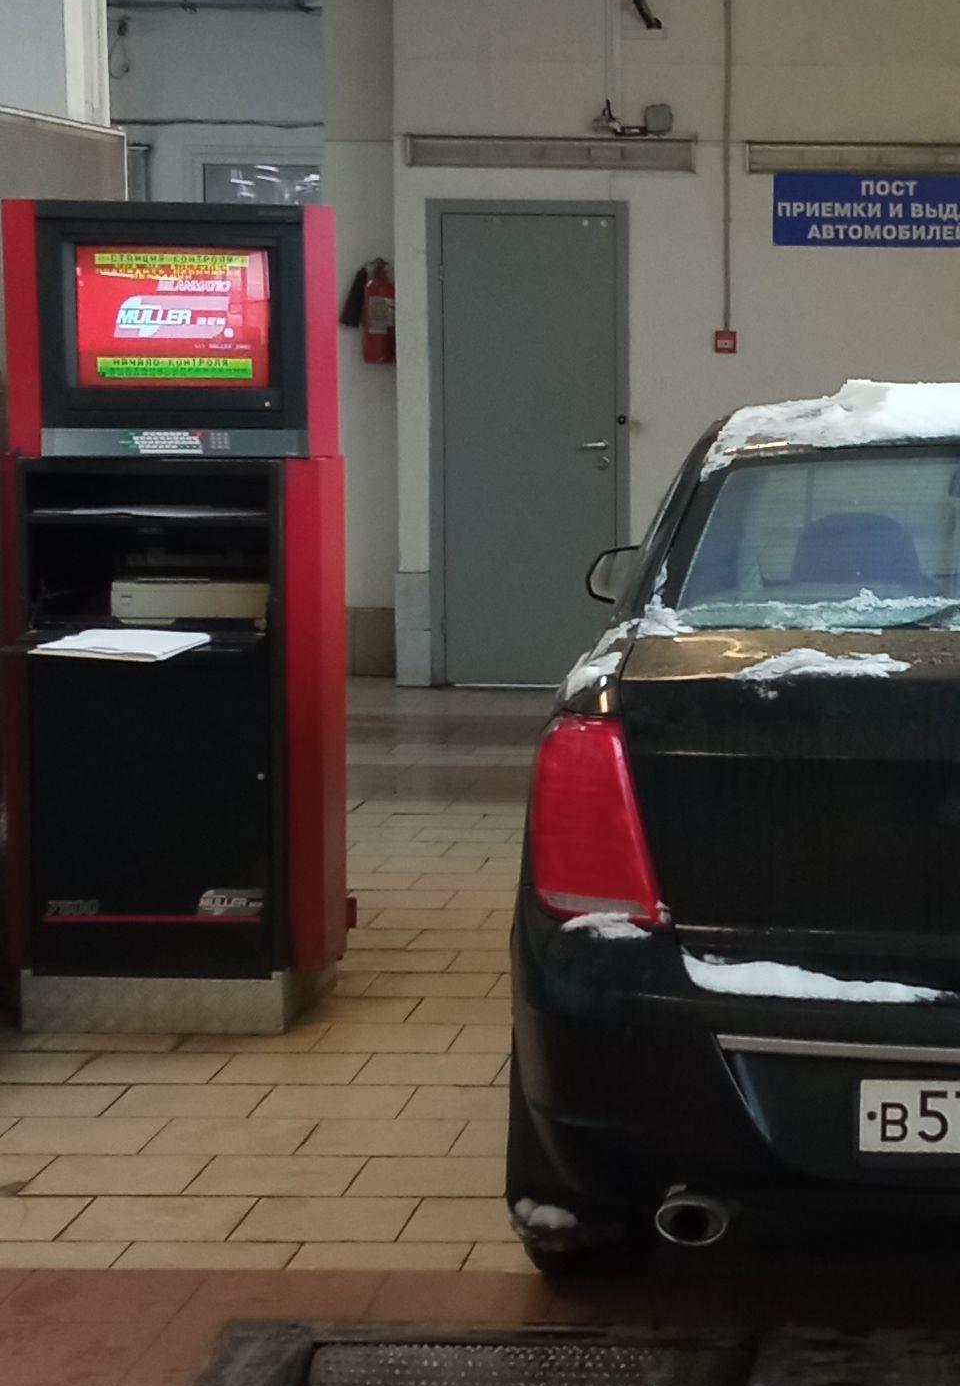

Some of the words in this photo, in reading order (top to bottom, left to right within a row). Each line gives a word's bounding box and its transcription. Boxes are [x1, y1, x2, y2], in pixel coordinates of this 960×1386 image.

[861, 180, 918, 196] ПОСТ
[777, 202, 882, 218] ПРИЕМКИ
[889, 203, 903, 218] И
